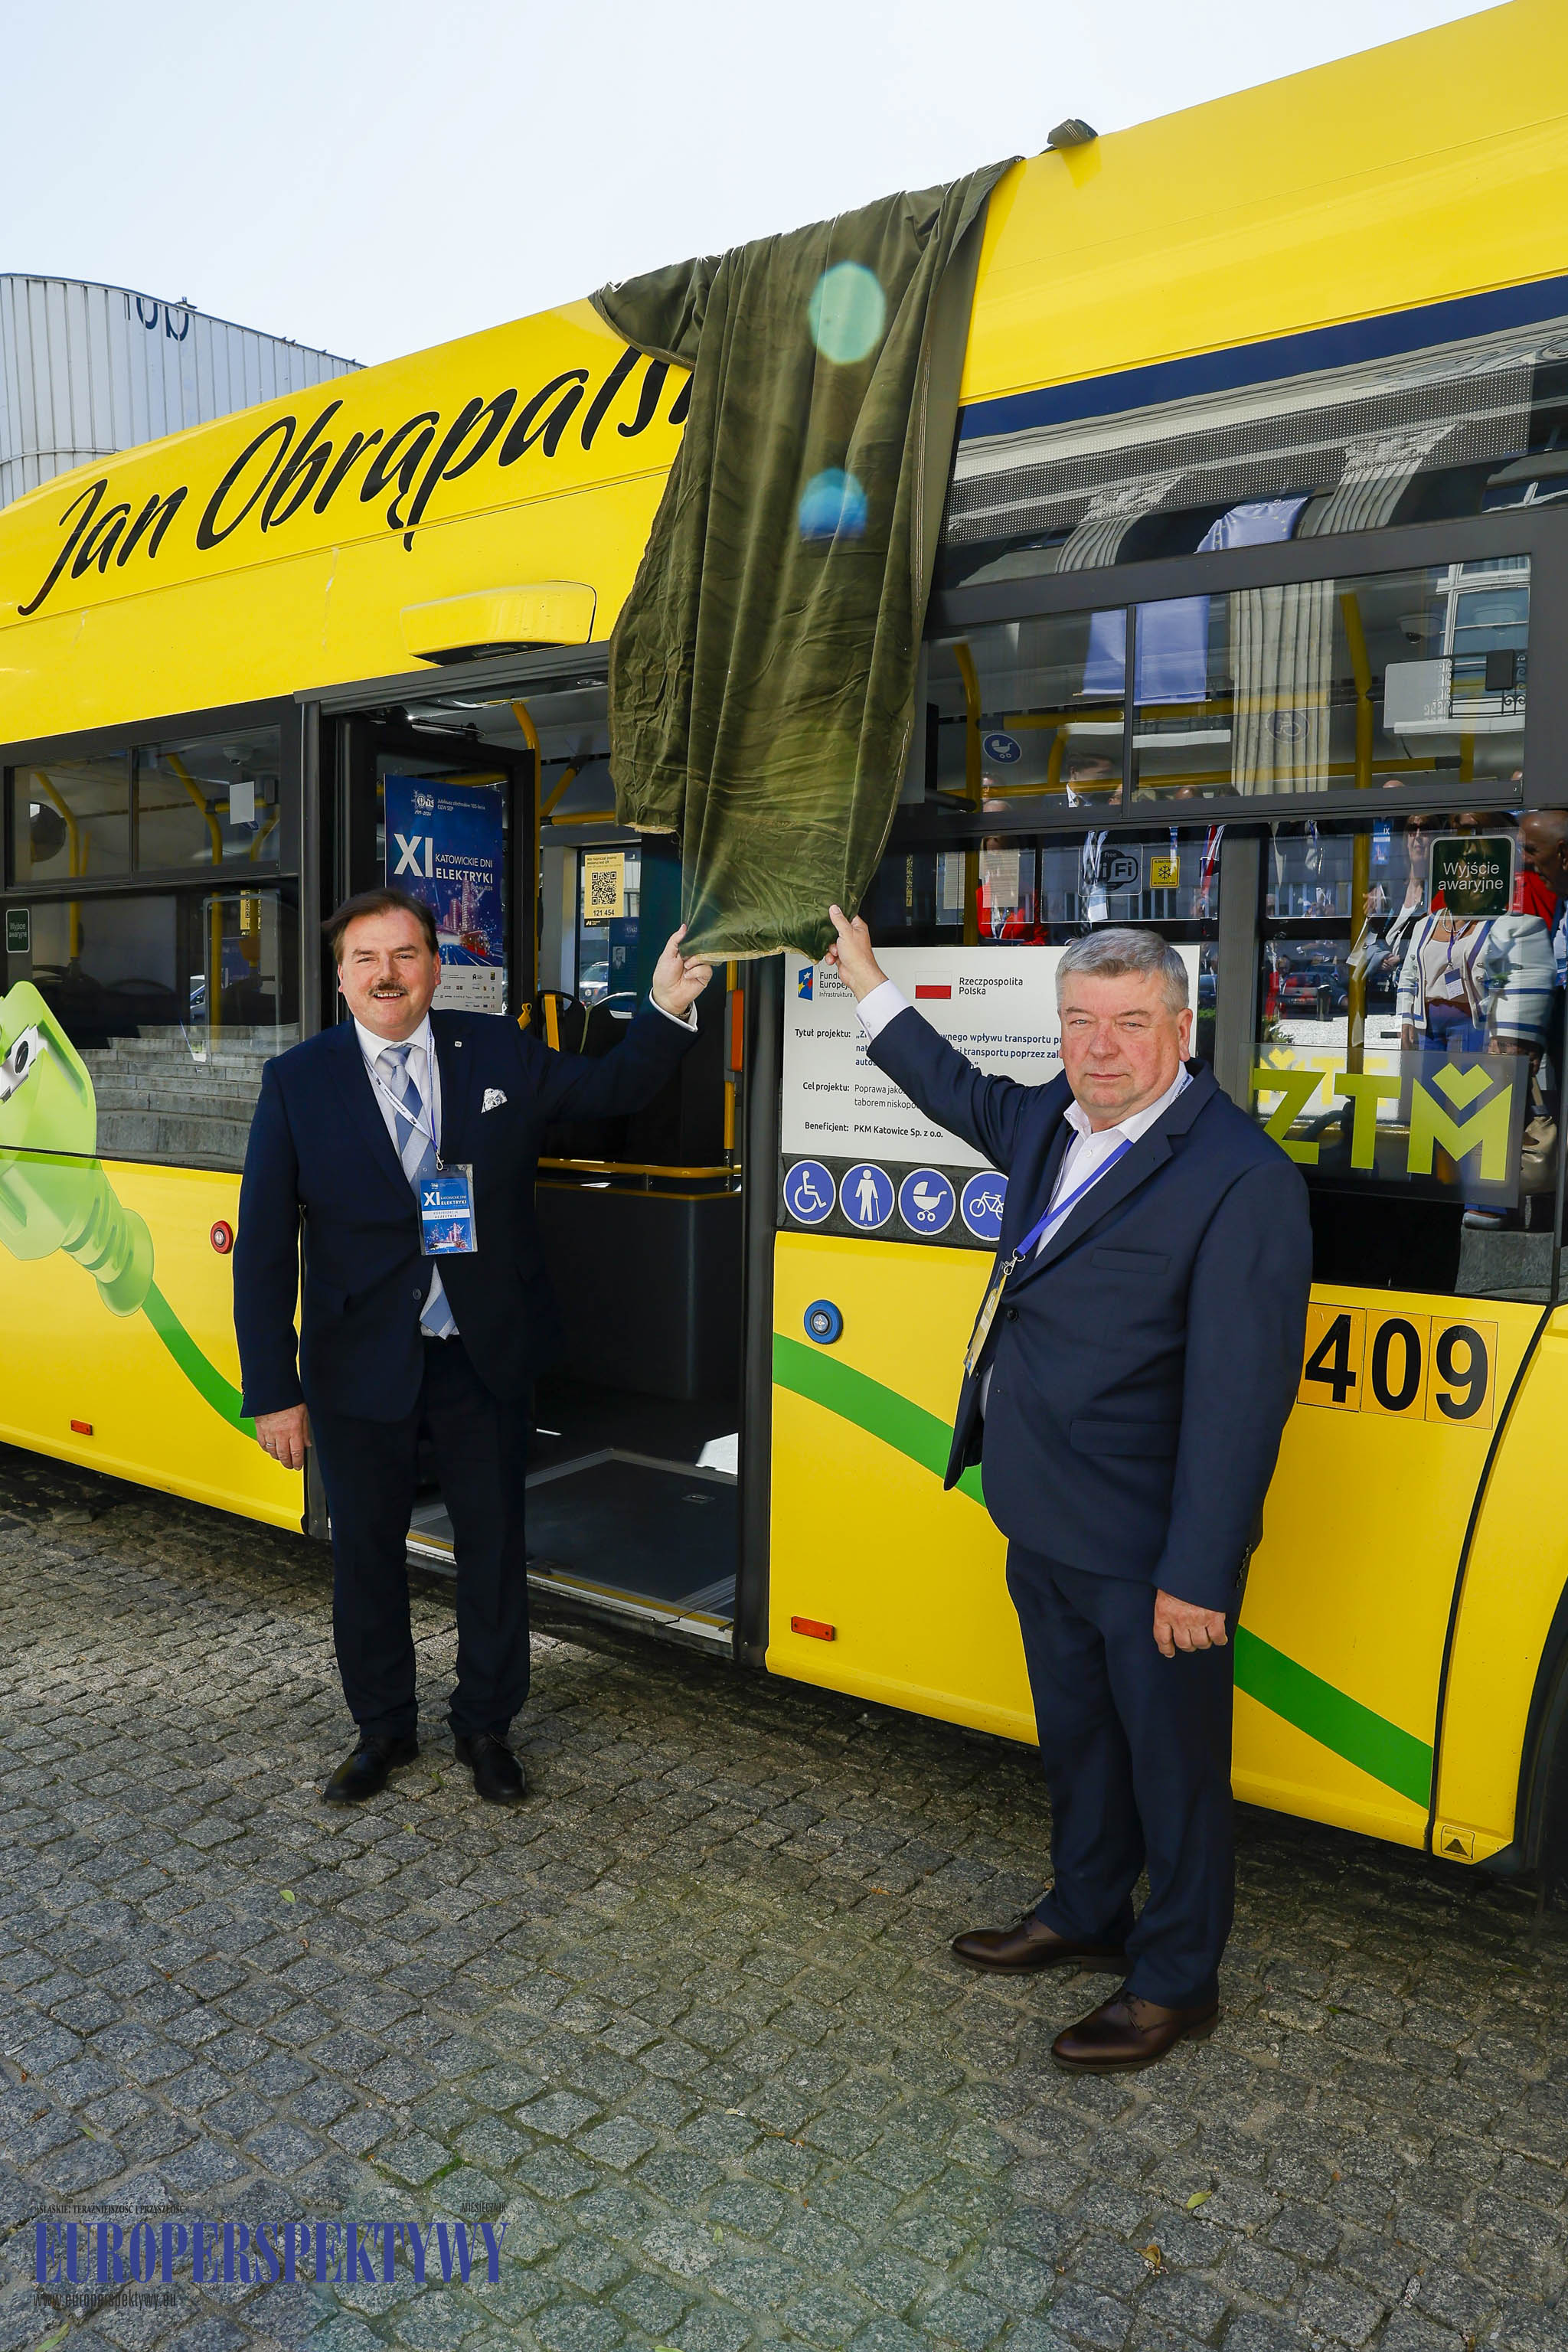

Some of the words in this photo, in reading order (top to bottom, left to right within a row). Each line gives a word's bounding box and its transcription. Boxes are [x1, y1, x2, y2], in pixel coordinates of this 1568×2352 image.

[18, 479, 188, 616] Jan
[196, 345, 695, 552] Obrąpals
[394, 833, 433, 877] XI
[435, 854, 479, 867] KATOWICKIE
[480, 858, 492, 868] DNI
[436, 867, 492, 884] ELEKTRYKI
[1443, 861, 1500, 878] Wyjście
[1438, 879, 1504, 893] awaryjne
[819, 981, 850, 989] Europej
[959, 977, 1024, 987] Rzeczpospolita
[959, 987, 986, 995] Polska
[795, 1029, 814, 1038] Tytuł
[817, 1029, 851, 1038] projektu:
[970, 1033, 1002, 1043] wpływu
[1004, 1034, 1051, 1044] transportu
[963, 1047, 1008, 1057] transportu
[1010, 1050, 1044, 1059] poprzez
[802, 1082, 815, 1090] Cel
[816, 1083, 850, 1092] projektu:
[854, 1084, 886, 1093] Poprawa
[887, 1086, 904, 1095] jako
[854, 1099, 886, 1107] taborem
[887, 1099, 918, 1110] niskopo
[1253, 1063, 1513, 1181] ZTM
[805, 1122, 849, 1132] Beneficjent:
[854, 1125, 871, 1133] PKM
[874, 1126, 909, 1135] Katowice
[910, 1129, 922, 1138] Sp.
[423, 1191, 440, 1207] XI
[1304, 1313, 1488, 1420] 409
